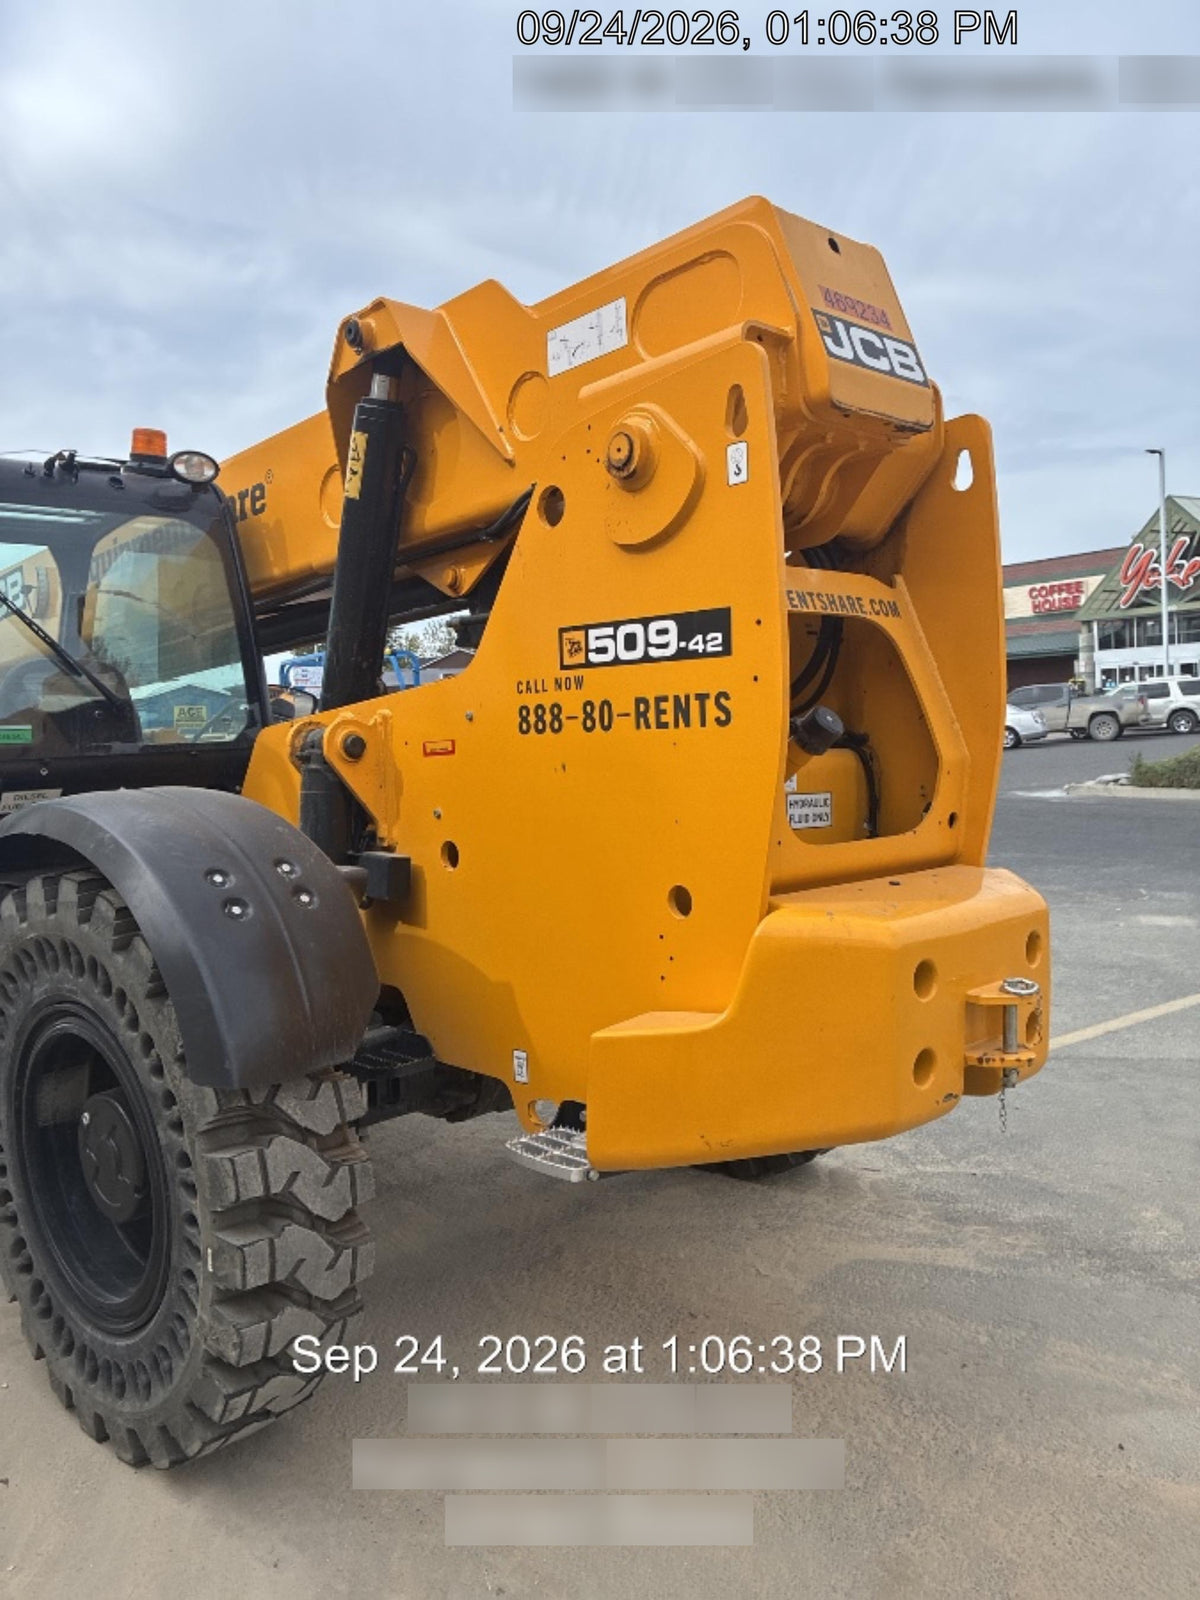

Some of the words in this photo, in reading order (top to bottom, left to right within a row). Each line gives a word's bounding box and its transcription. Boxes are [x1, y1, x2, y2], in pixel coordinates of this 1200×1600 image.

[823, 286, 892, 328] 469234
[822, 320, 926, 383] JCB
[1028, 580, 1084, 600] COFFEE
[1031, 595, 1082, 614] HOUSE
[587, 620, 723, 664] 509-42
[516, 678, 548, 695] CALL
[555, 675, 584, 692] NOW
[518, 691, 732, 735] 888-80-RENTS
[789, 797, 830, 809] HYDRAULIC
[789, 813, 810, 824] FLUID
[812, 811, 830, 822] ONLY
